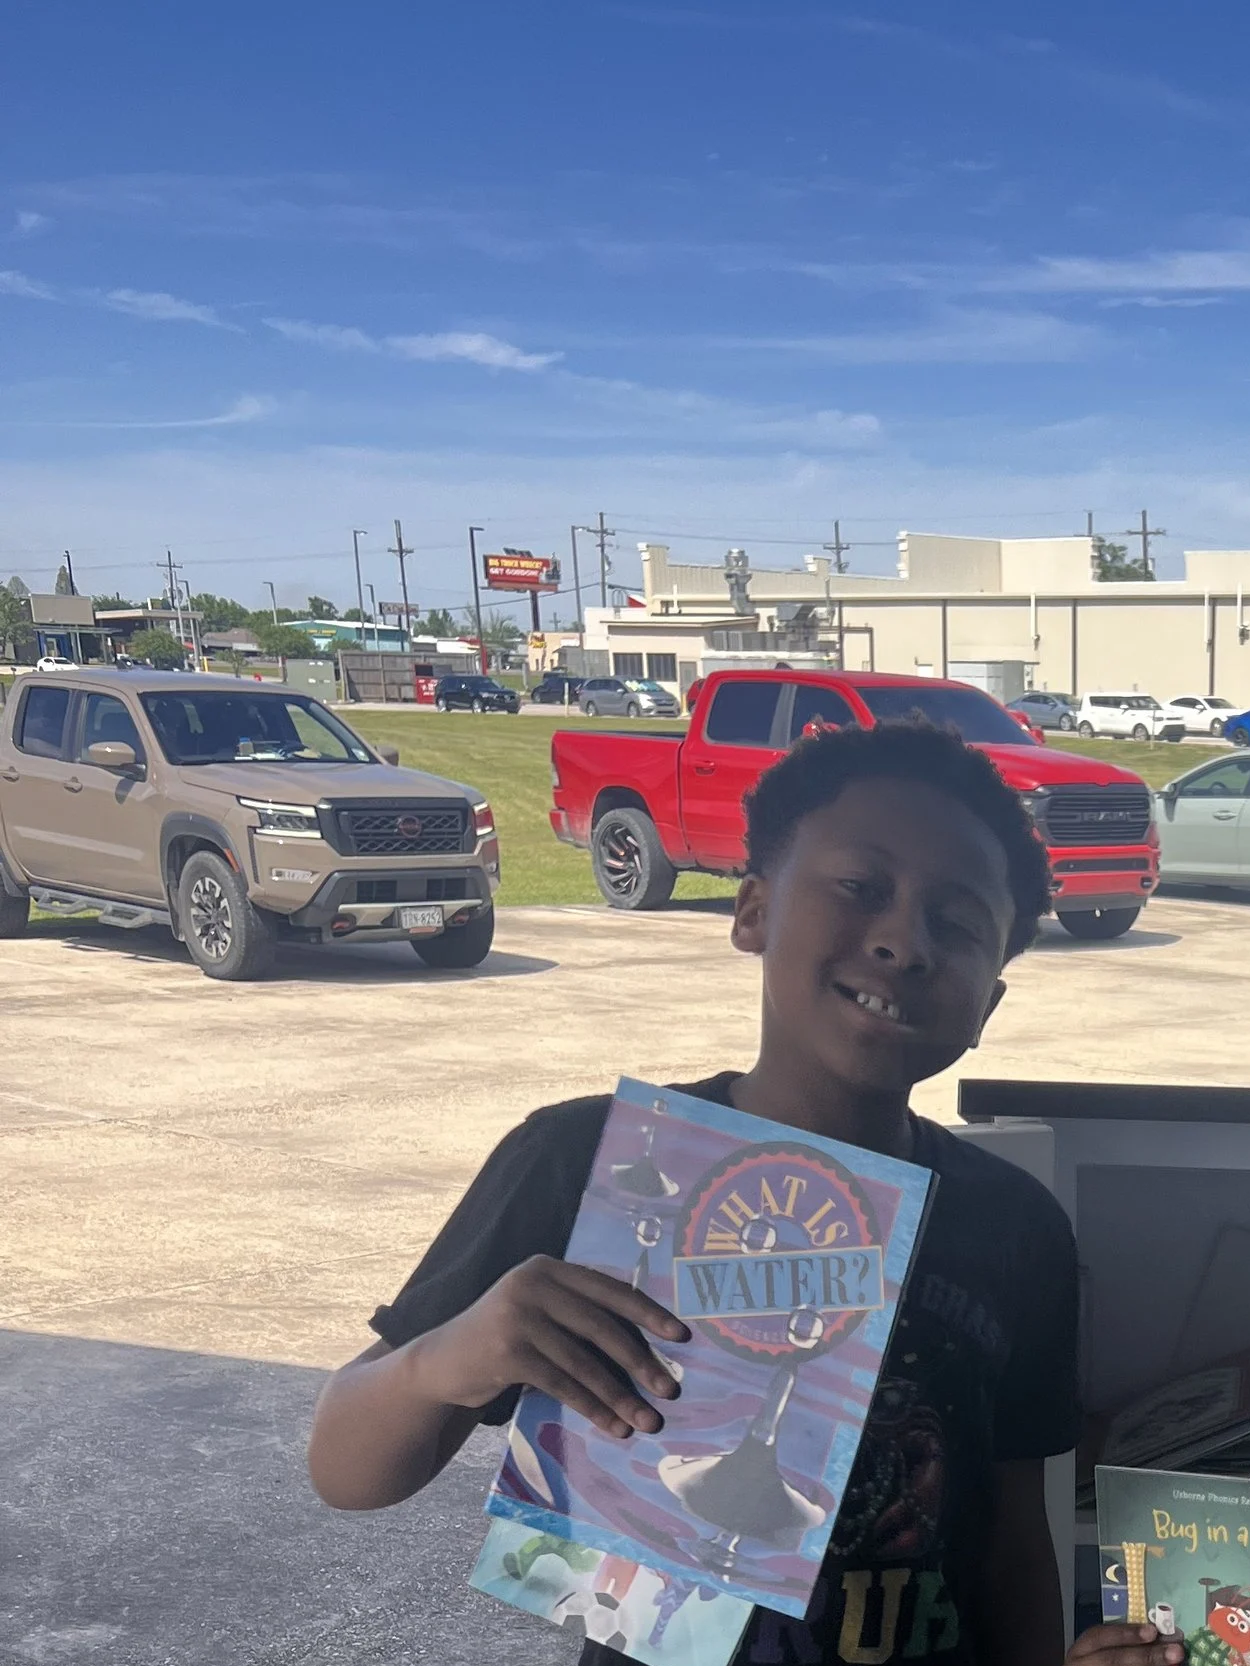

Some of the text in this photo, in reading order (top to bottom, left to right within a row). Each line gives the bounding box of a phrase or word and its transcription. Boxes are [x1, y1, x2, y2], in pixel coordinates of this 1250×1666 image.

[703, 1175, 849, 1251] WHAT IS
[686, 1252, 871, 1313] WATER?
[1172, 1489, 1206, 1501] Usborne
[1207, 1492, 1239, 1505] Phonics
[1152, 1508, 1198, 1554] Bug
[1206, 1517, 1229, 1544] in
[1236, 1526, 1249, 1547] a
